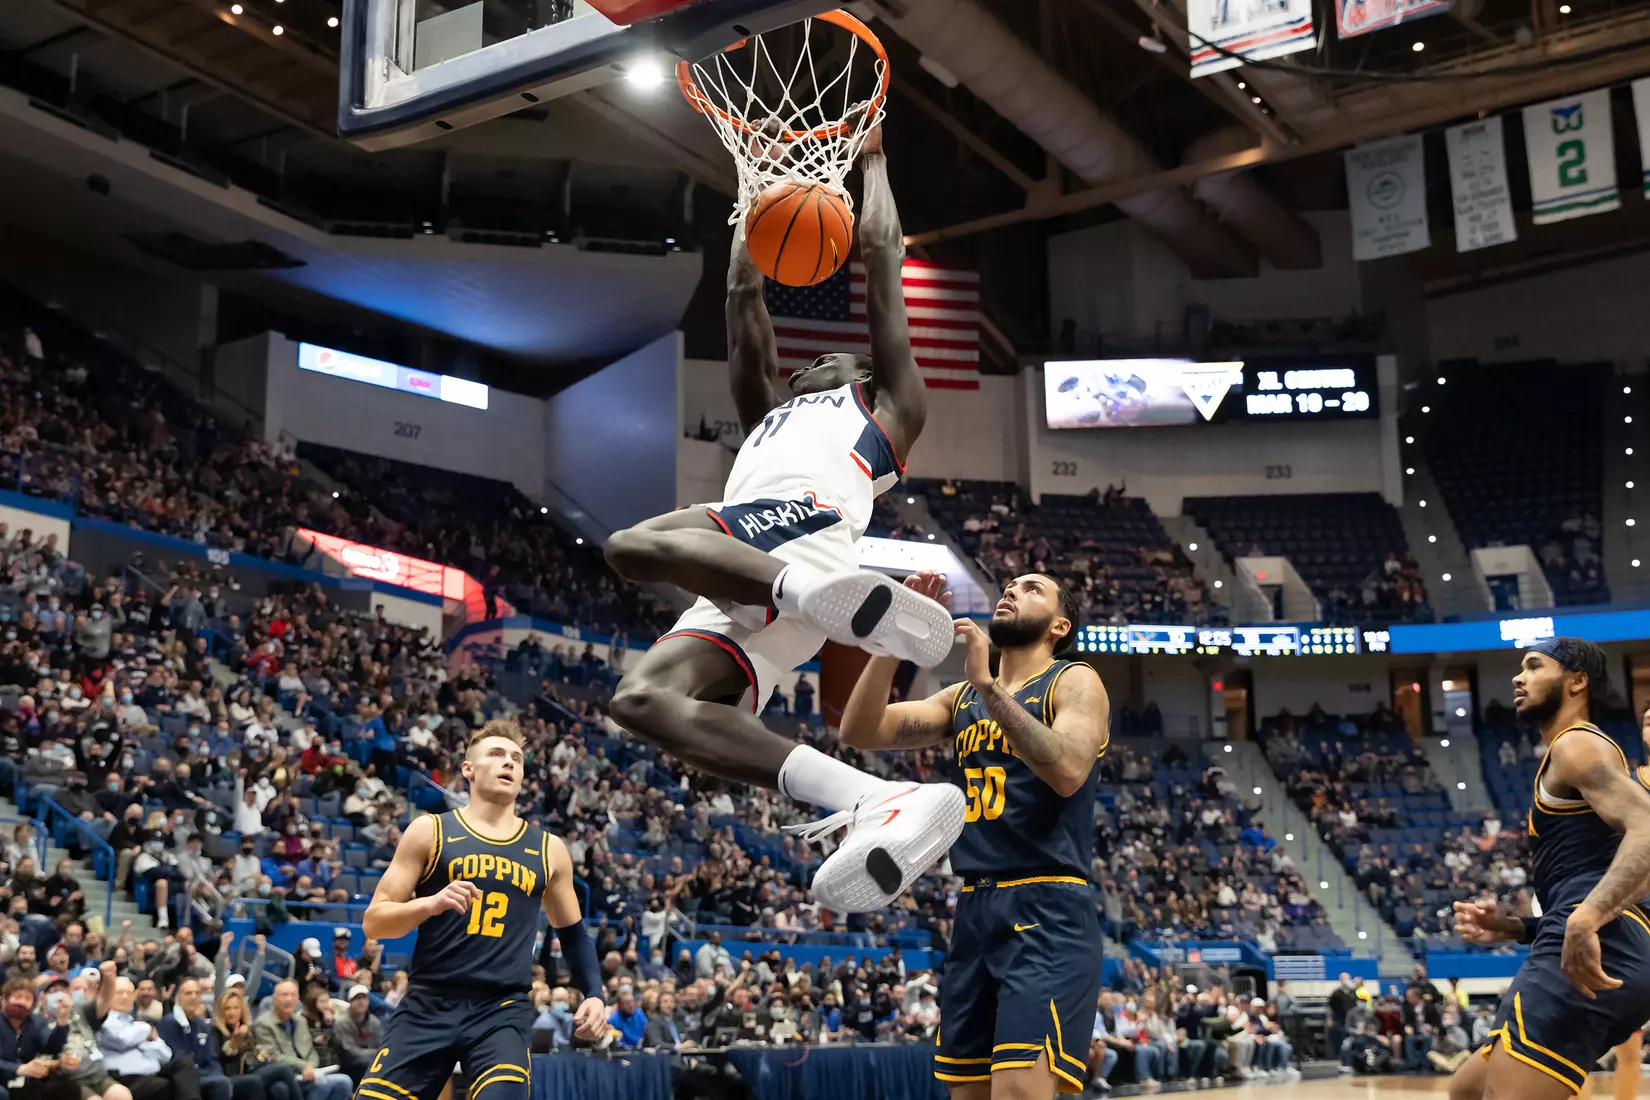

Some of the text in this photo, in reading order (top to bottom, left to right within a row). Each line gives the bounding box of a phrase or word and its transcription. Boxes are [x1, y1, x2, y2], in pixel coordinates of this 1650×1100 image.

[1557, 139, 1588, 187] 2
[394, 421, 422, 440] 207
[753, 410, 792, 448] 11
[1051, 461, 1078, 477] 232
[1264, 464, 1292, 480] 233
[956, 719, 1020, 767] COPPI
[964, 766, 1007, 823] 50
[448, 853, 537, 897] COPPIN
[466, 889, 509, 938] 12
[369, 1047, 390, 1073] C
